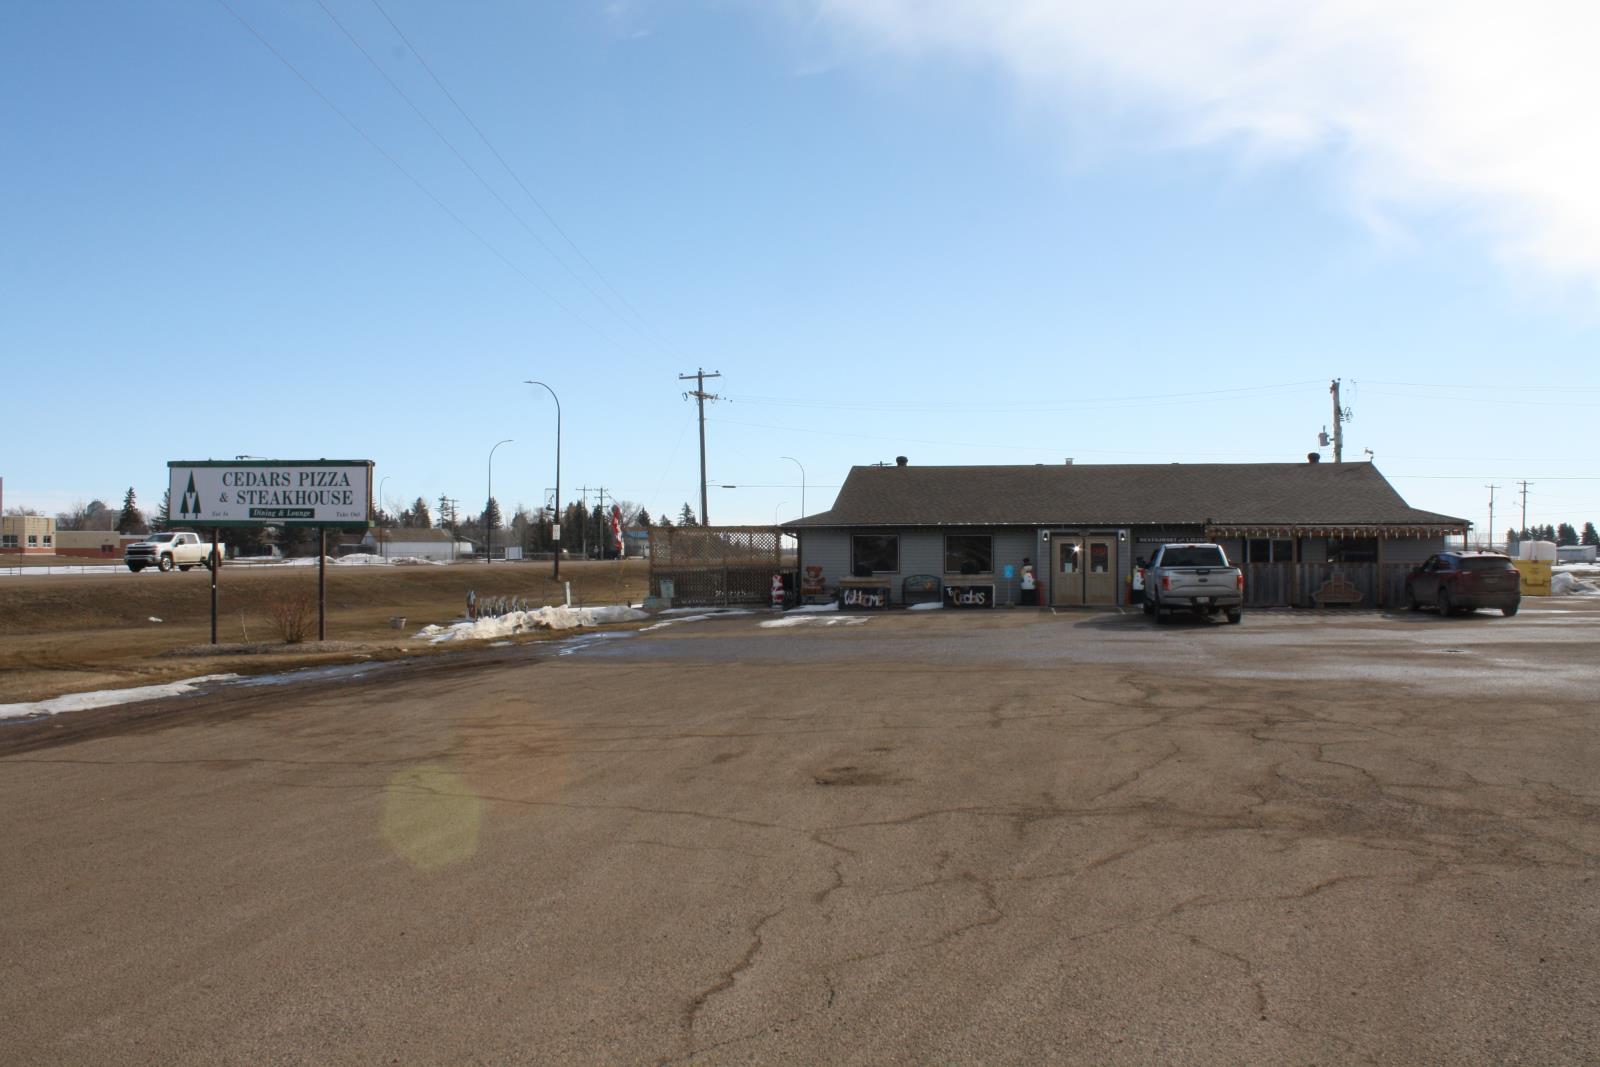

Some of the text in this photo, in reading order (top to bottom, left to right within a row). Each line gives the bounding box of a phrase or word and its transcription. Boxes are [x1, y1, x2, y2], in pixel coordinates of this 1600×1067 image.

[222, 471, 351, 487] CEDARS PIZZA
[219, 490, 353, 505] & STEAKHOUSE
[253, 508, 312, 518] Dining & Lounge
